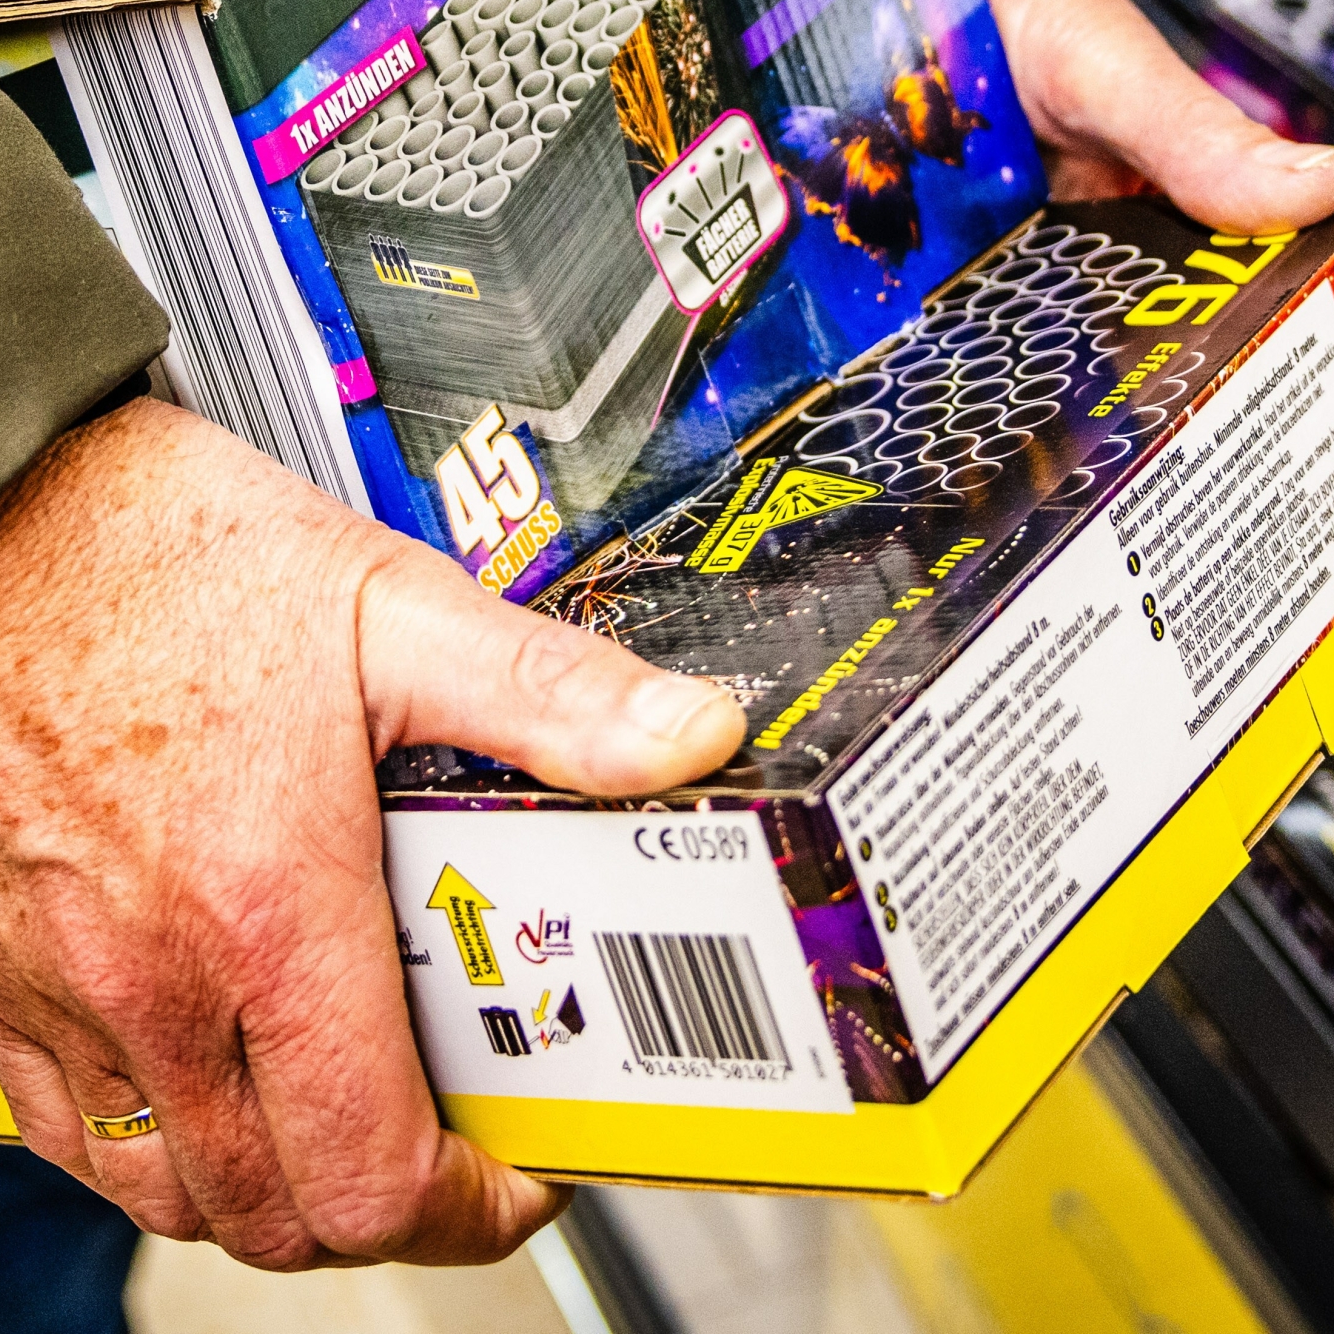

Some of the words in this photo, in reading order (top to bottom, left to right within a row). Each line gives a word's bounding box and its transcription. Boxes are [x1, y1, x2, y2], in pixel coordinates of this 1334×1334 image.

[290, 119, 320, 155] 1x
[312, 39, 416, 139] ANZÜNDEN
[694, 196, 752, 262] FÄCHER
[705, 219, 761, 281] BATTERIE
[1087, 342, 1182, 418] Effekte
[435, 403, 541, 556] 45
[1115, 520, 1141, 552] Alleen
[1137, 504, 1156, 529] voor
[1153, 473, 1182, 517] gebruik
[1175, 440, 1217, 488] buitenshuis.
[1211, 408, 1244, 450] Minimale
[1240, 352, 1296, 419] veiligheidsafstand:
[1291, 346, 1301, 364] 8
[1298, 332, 1319, 359] meter.
[684, 456, 777, 569] Explosivmasse
[1107, 444, 1186, 530] Gebruiksaanwijzing:
[1139, 524, 1168, 561] Vermijd
[1164, 498, 1196, 537] obstructies
[1192, 480, 1214, 510] boven
[1209, 467, 1223, 487] het
[1221, 418, 1266, 476] vuurwerkartikel.
[478, 500, 562, 597] SCHUSS
[708, 556, 733, 568] g
[727, 517, 765, 552] 307
[929, 536, 986, 581] Nur
[892, 586, 935, 613] 1x
[753, 617, 898, 751] anzünden!
[681, 825, 750, 860] 0589
[448, 895, 484, 979] Schussrichtung
[464, 898, 497, 976] Schietrichting
[621, 1058, 633, 1075] 4
